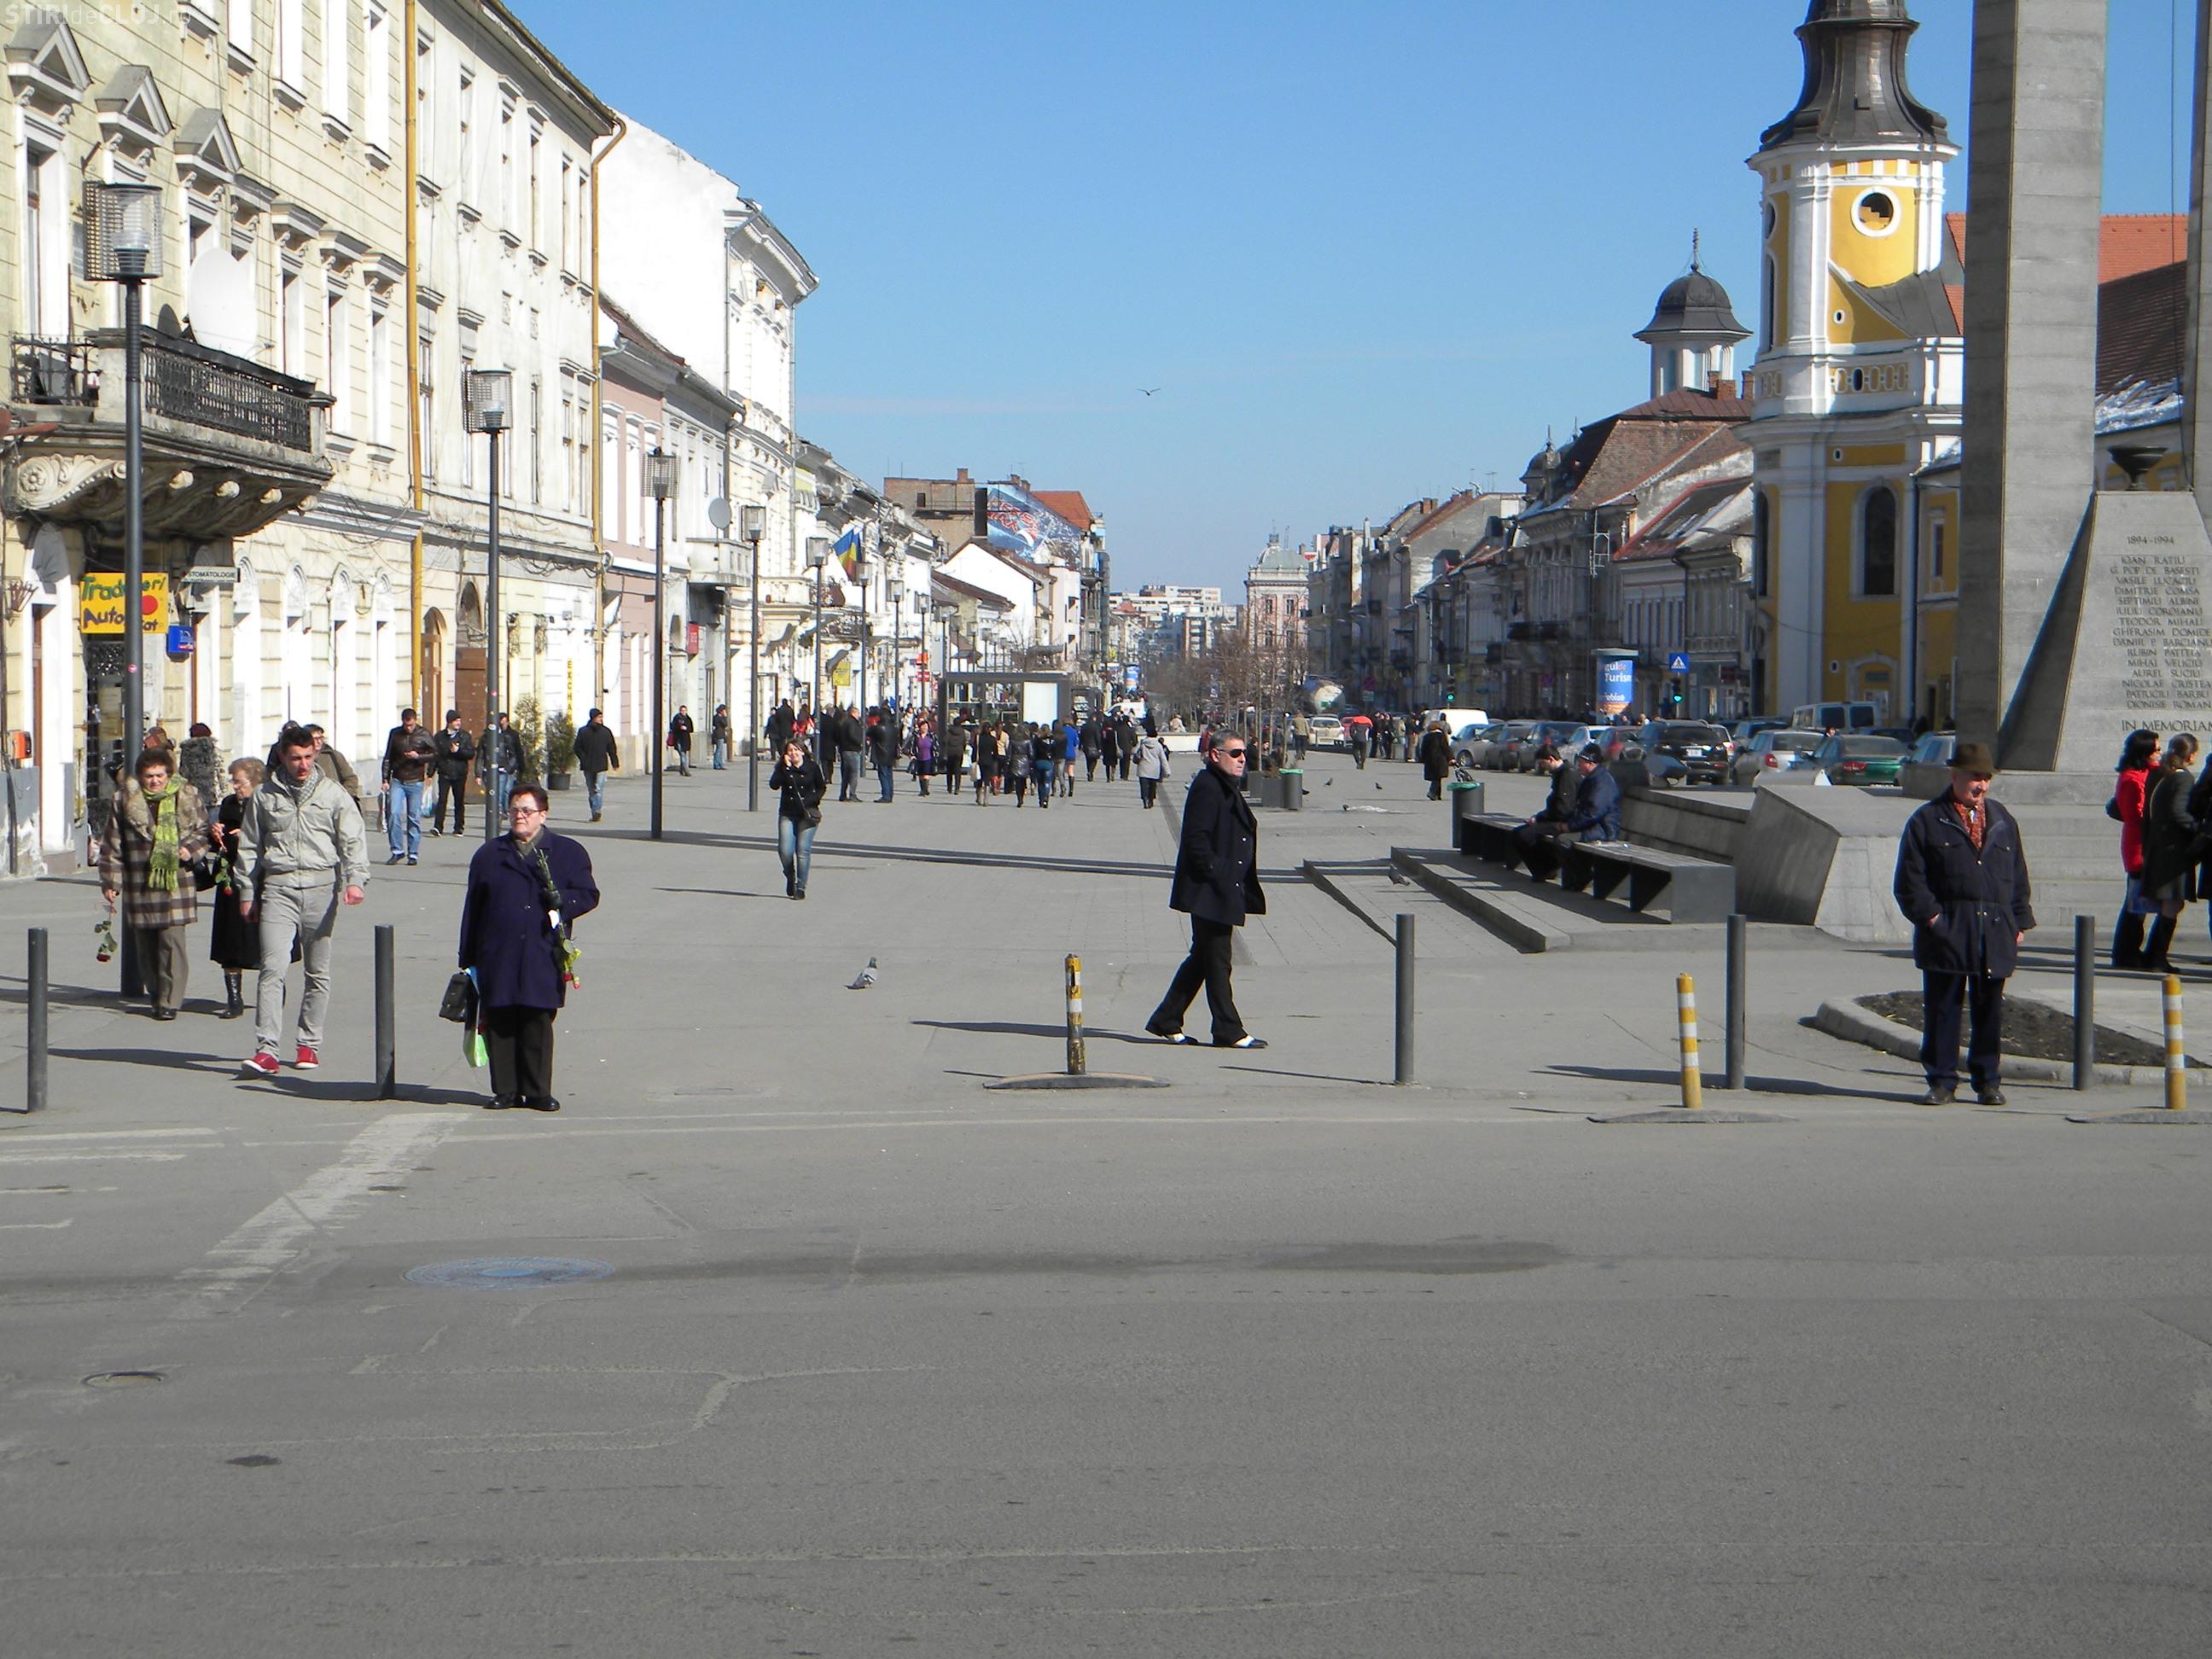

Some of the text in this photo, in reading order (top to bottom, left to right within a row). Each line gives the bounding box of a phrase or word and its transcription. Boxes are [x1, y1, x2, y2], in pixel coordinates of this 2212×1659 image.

[81, 576, 166, 601] Traderi
[2127, 649, 2157, 657] RUBIN
[2122, 679, 2211, 688] NICOLAE CRISTEA
[2122, 720, 2136, 731] IN
